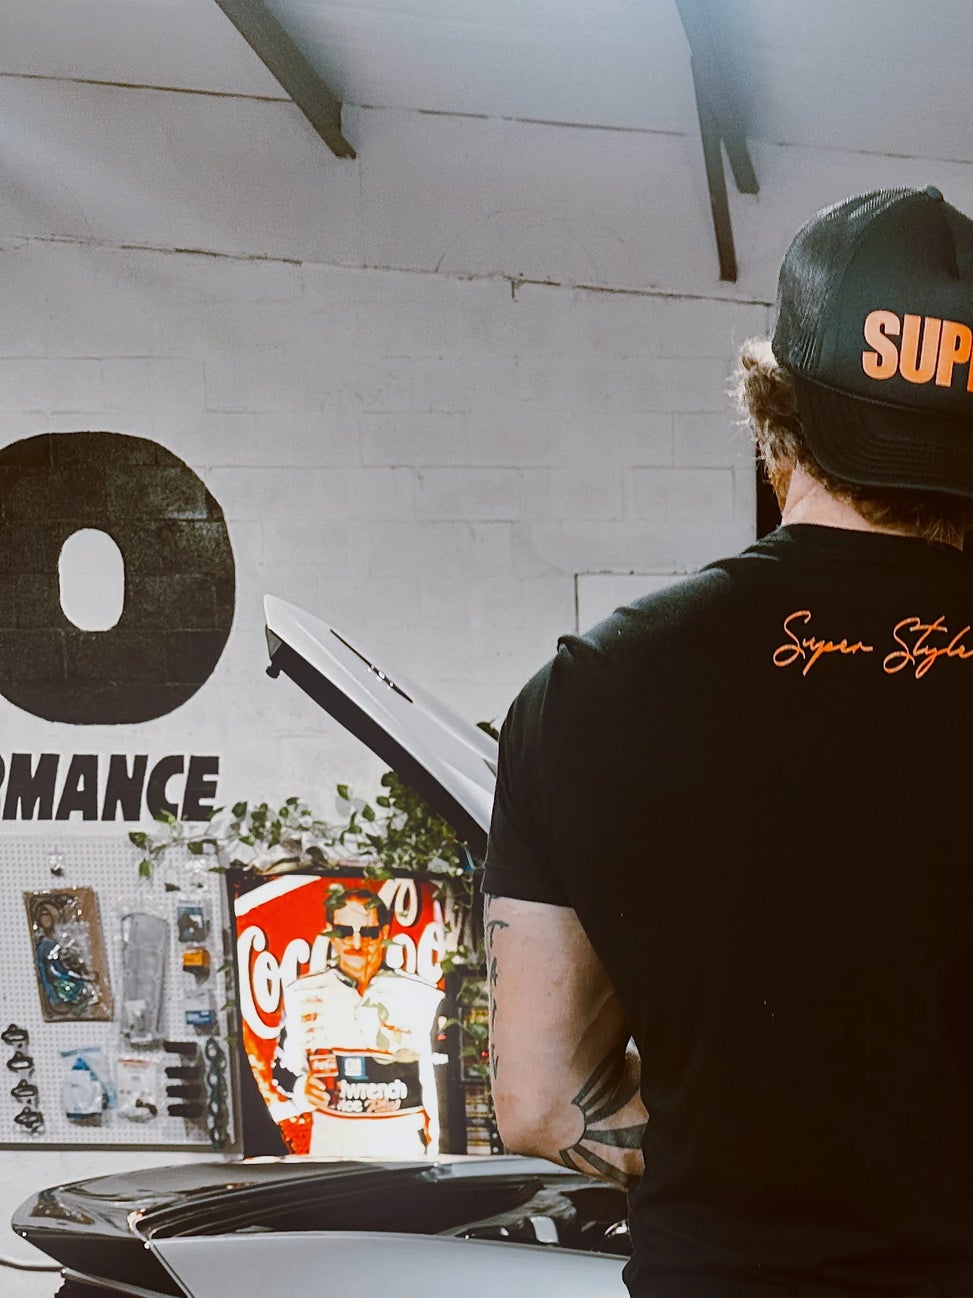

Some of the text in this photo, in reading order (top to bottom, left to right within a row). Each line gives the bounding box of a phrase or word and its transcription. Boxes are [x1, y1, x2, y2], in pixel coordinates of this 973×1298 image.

[773, 610, 973, 679] Super Style
[0, 753, 220, 822] MANCE
